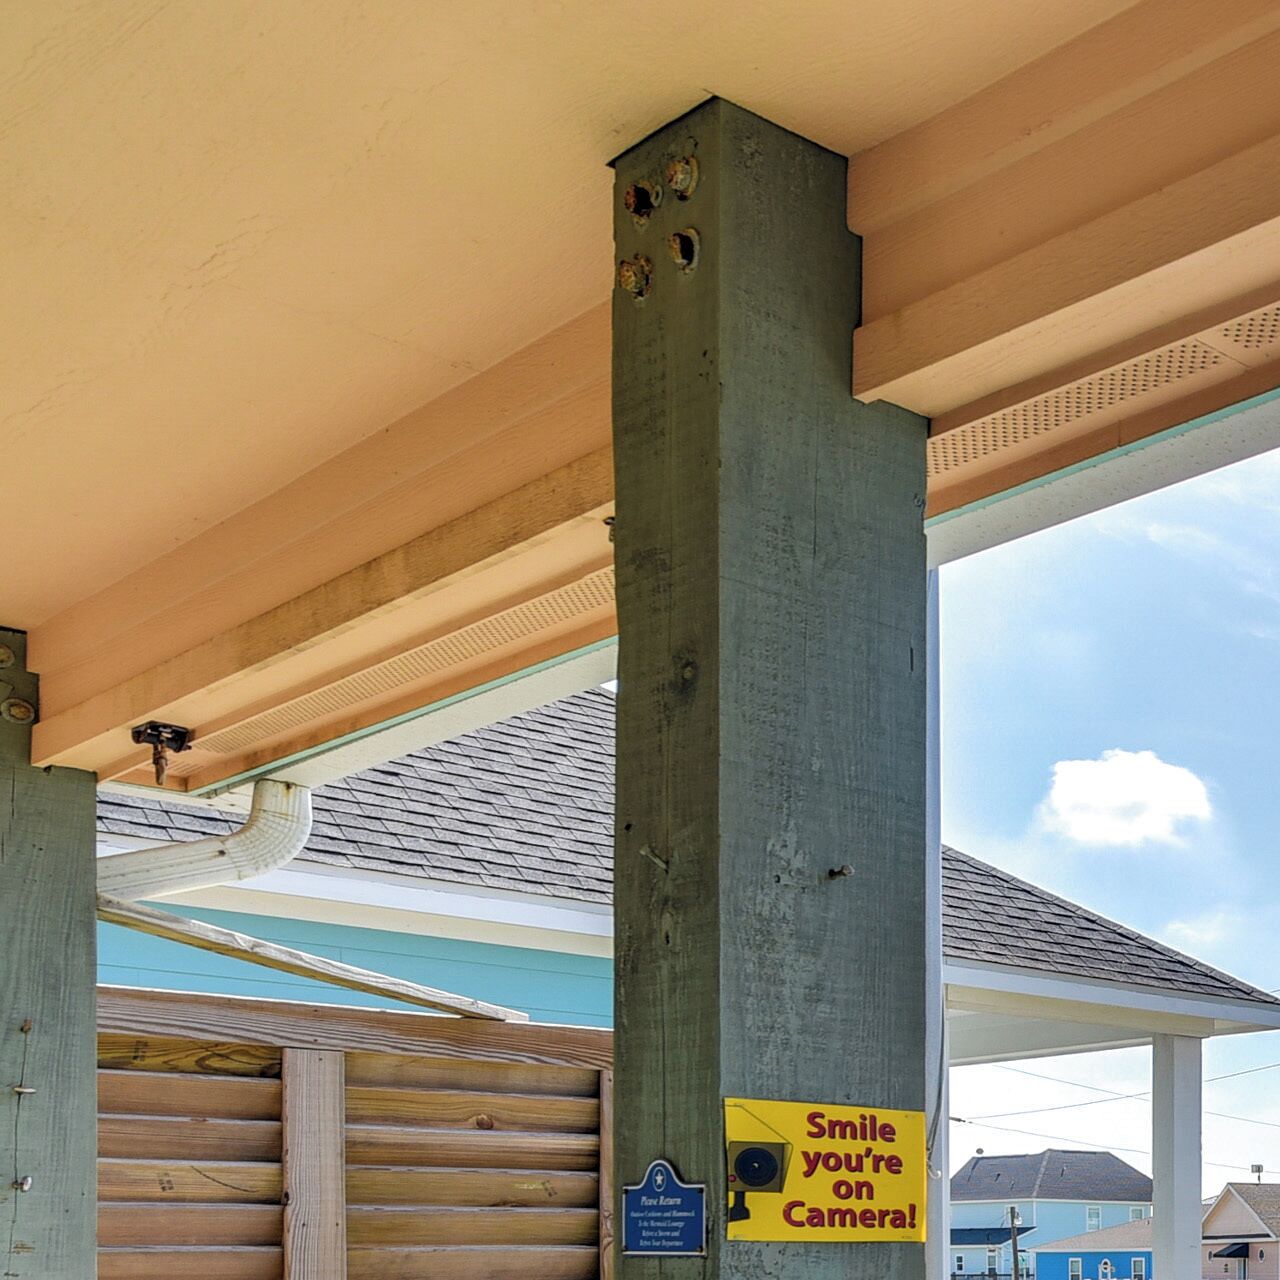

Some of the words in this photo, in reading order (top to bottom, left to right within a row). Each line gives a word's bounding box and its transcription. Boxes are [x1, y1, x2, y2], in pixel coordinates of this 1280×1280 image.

[806, 1111, 896, 1143] Smile
[800, 1147, 903, 1178] you're
[832, 1179, 874, 1200] on
[782, 1200, 917, 1229] Camera!
